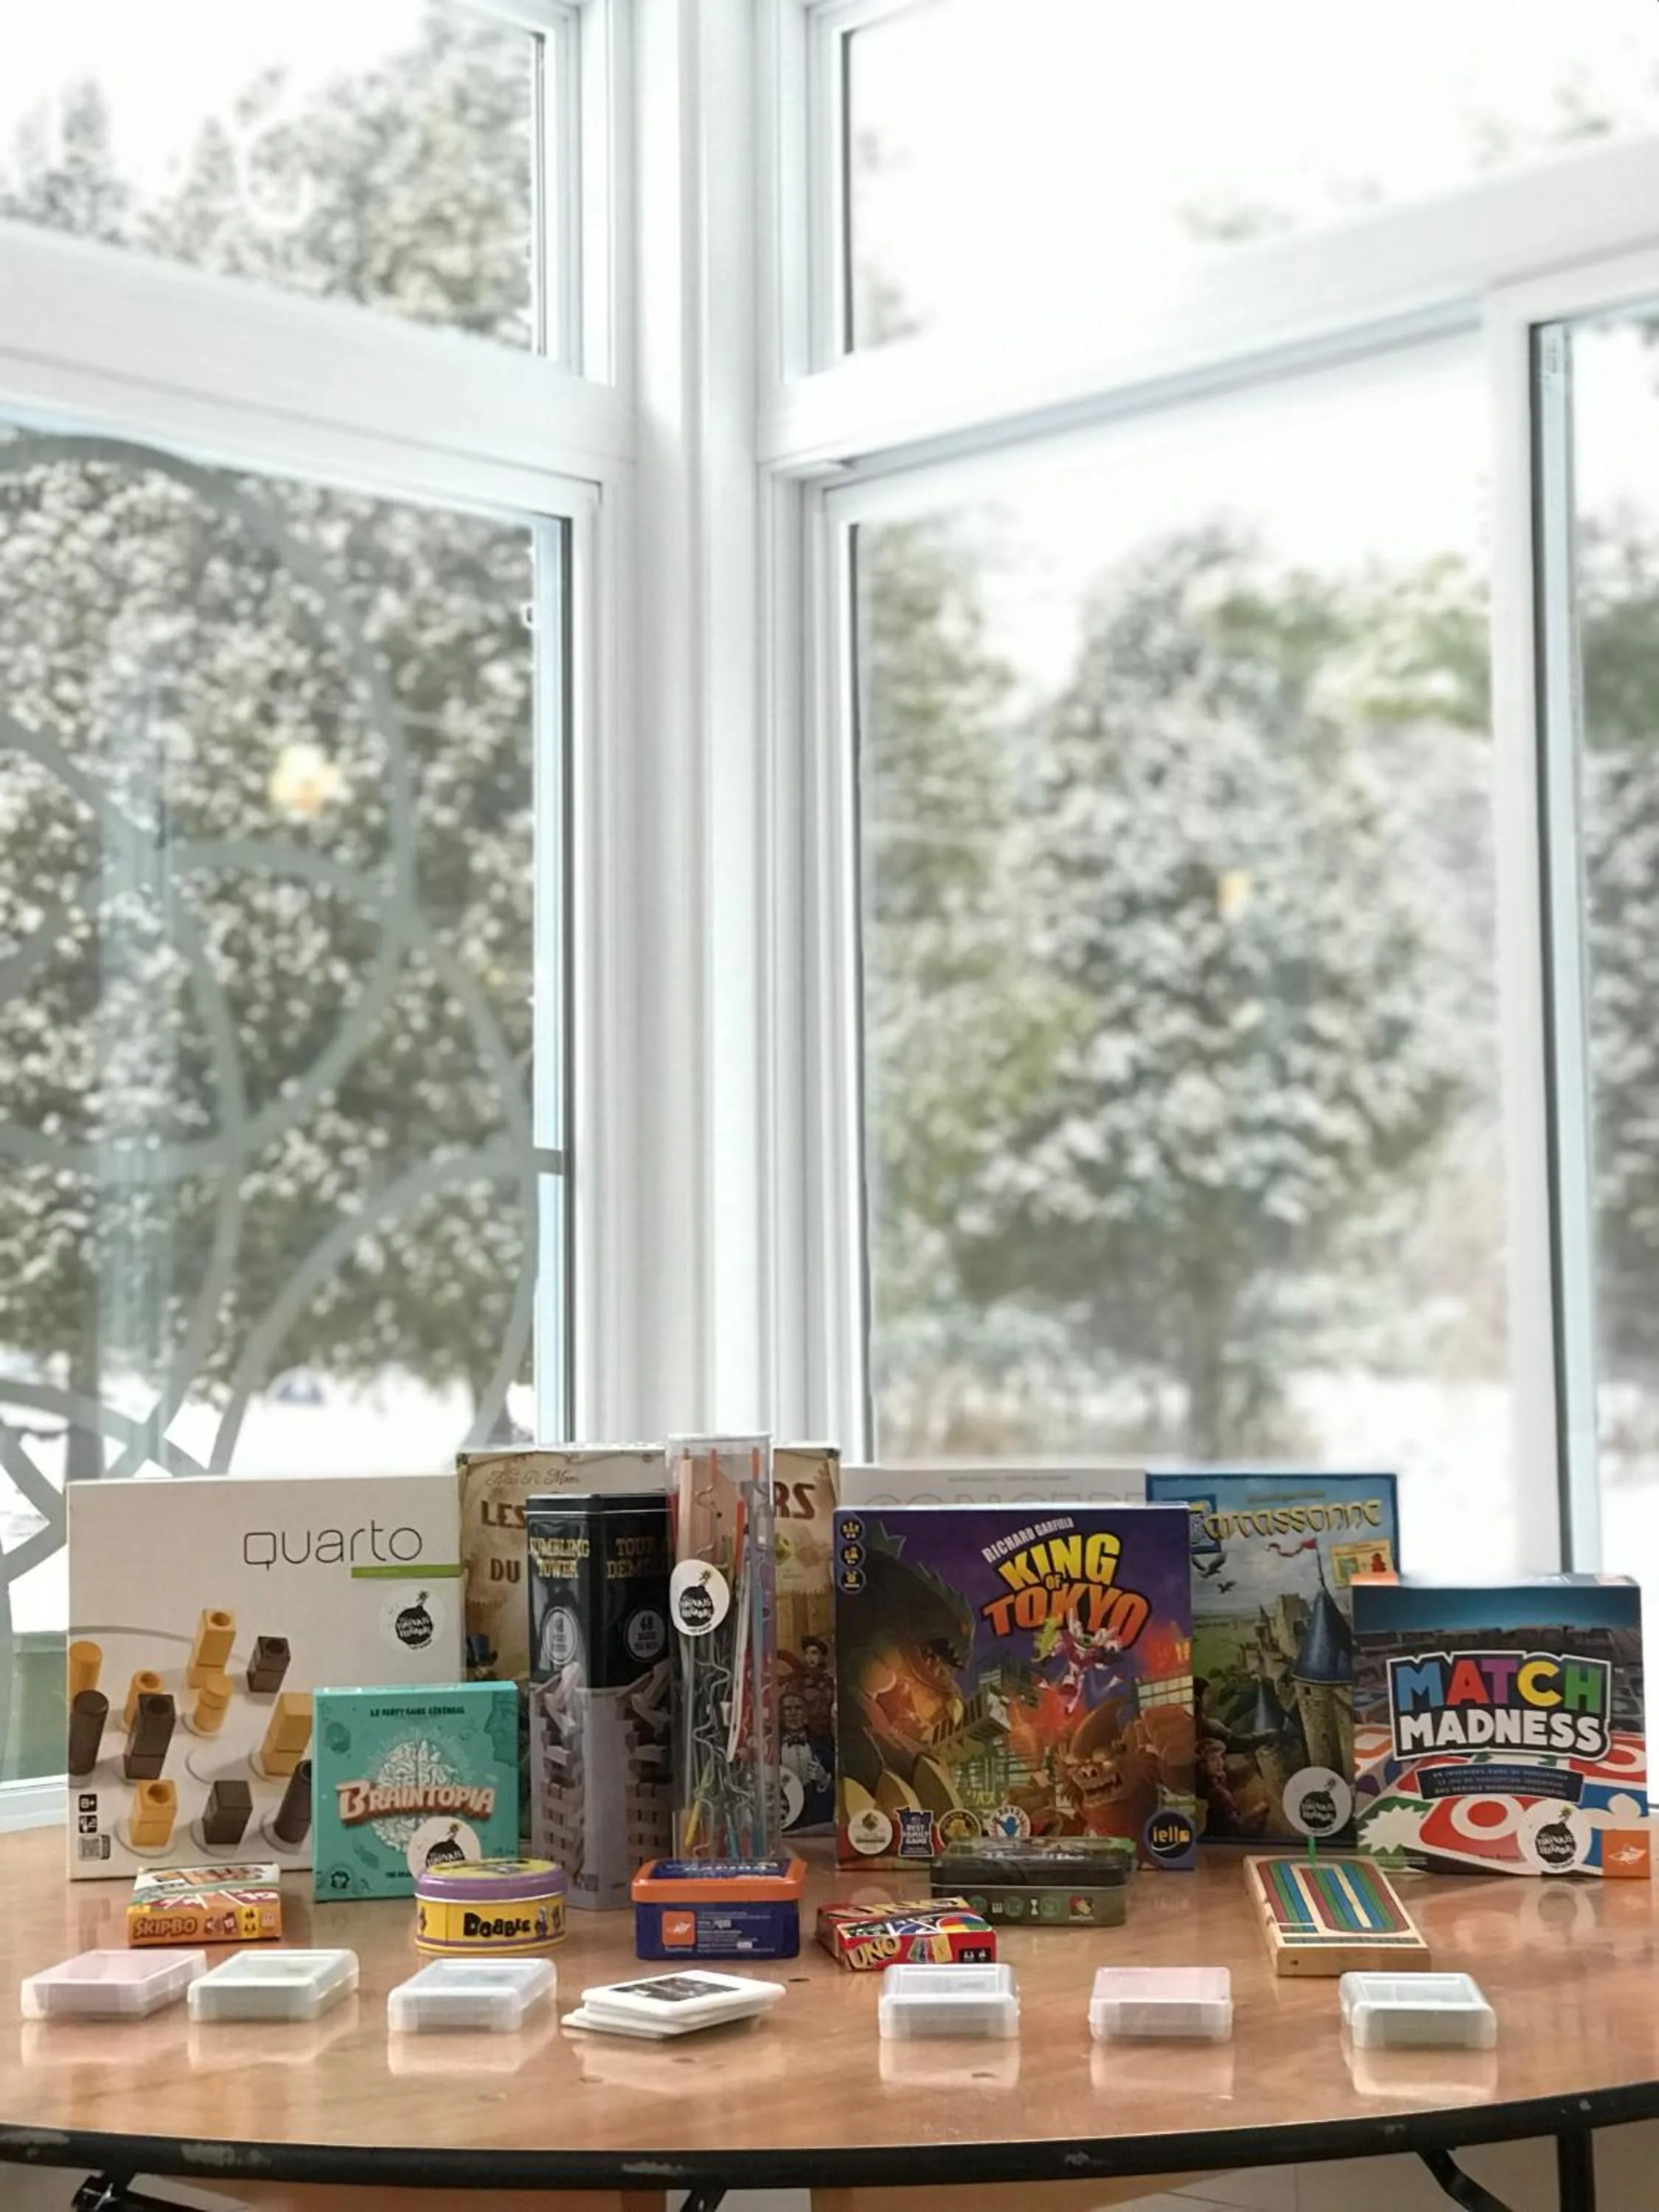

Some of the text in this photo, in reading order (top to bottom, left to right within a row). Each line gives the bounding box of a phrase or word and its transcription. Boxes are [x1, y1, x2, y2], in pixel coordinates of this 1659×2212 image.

[981, 1526, 1035, 1564] RICHARD
[998, 1533, 1121, 1591] KING
[490, 1558, 521, 1583] DU
[1045, 1573, 1062, 1590] OF
[984, 1582, 1150, 1645] TOKYO
[1396, 1660, 1601, 1714] MATCH
[1399, 1708, 1602, 1753] MADNESS
[848, 1935, 900, 1969] UNO
